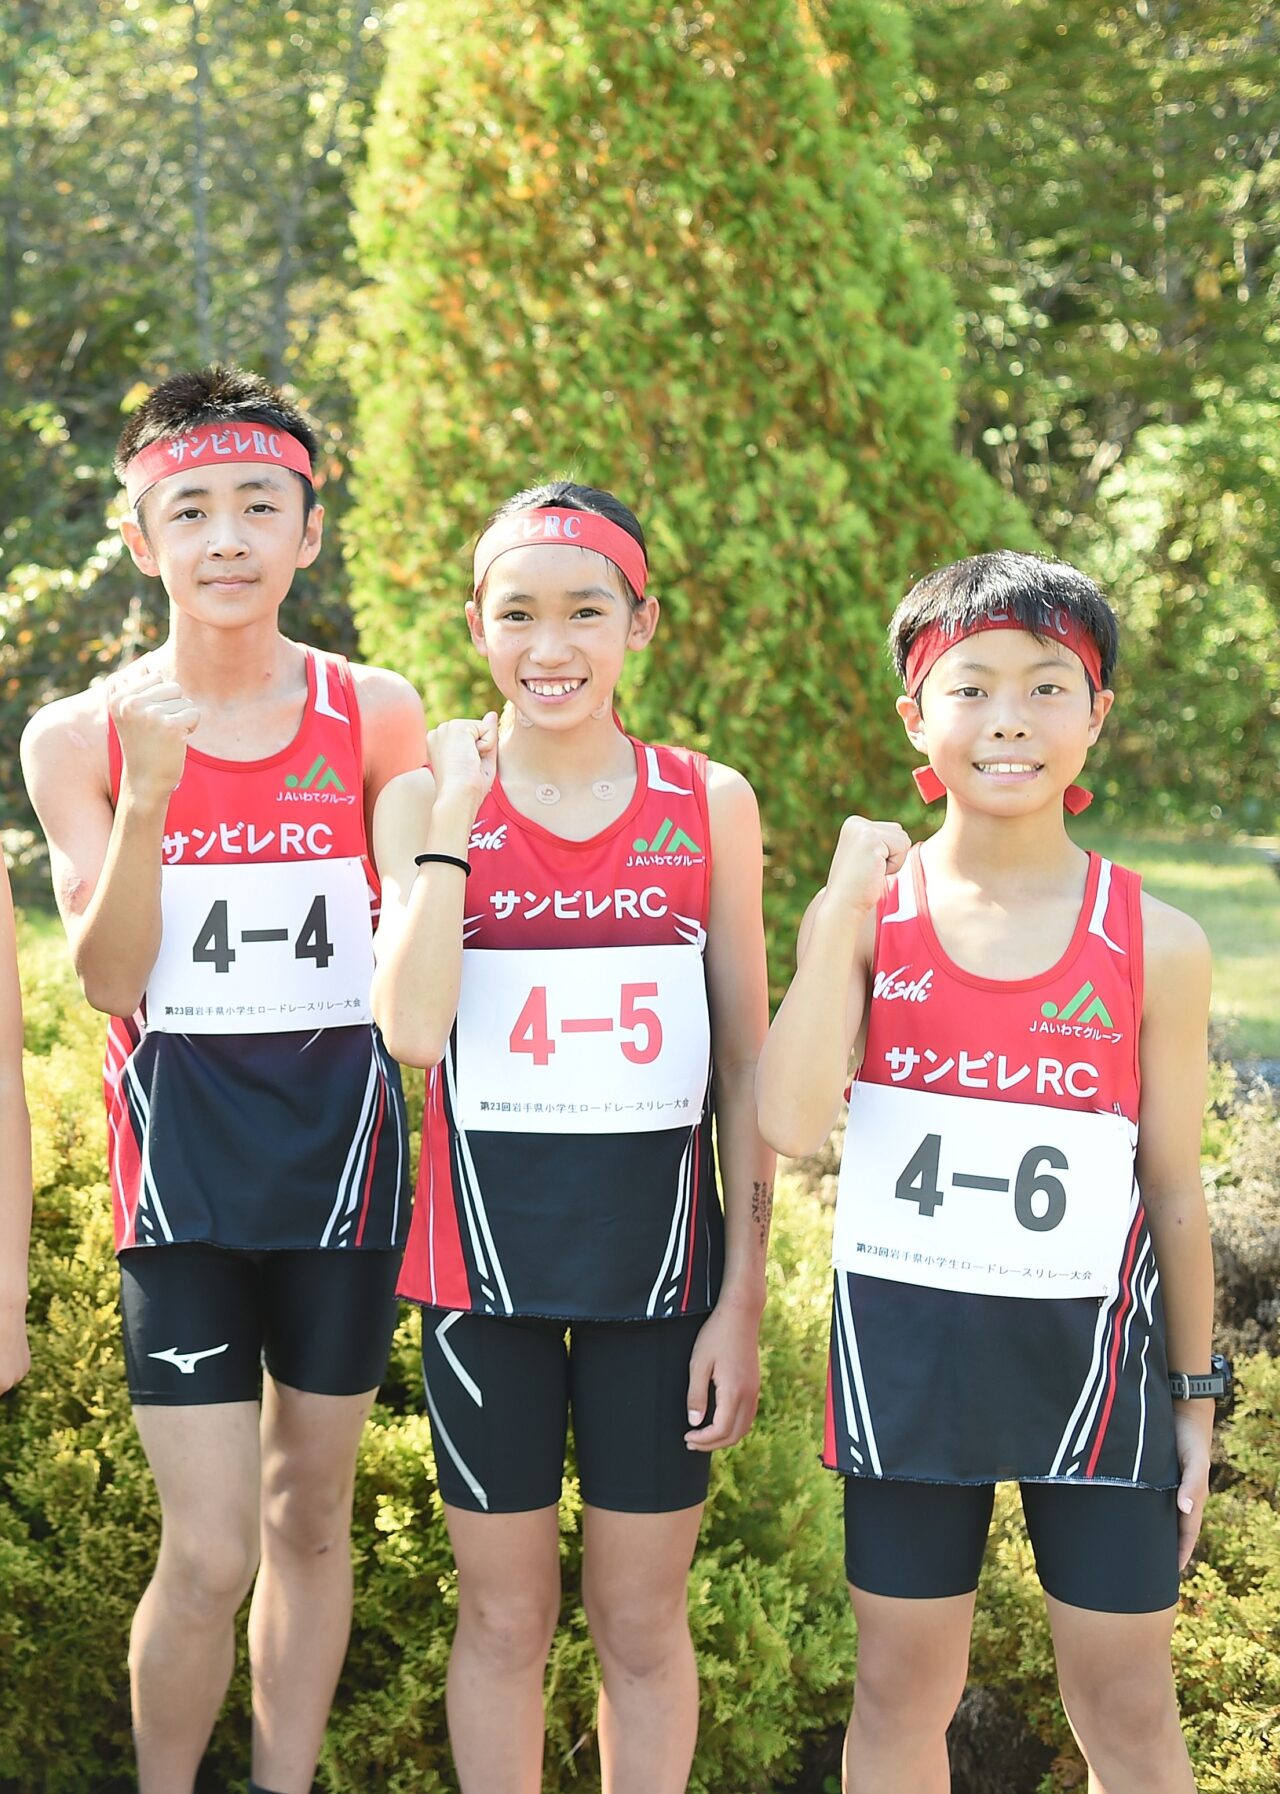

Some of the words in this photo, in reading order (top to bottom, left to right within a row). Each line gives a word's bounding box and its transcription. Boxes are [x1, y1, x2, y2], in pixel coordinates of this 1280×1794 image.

[167, 429, 283, 465] サンビレRC
[162, 821, 334, 865] サンビレRC
[626, 855, 705, 867] JAいわてグルー
[490, 886, 668, 920] サンビレRC
[193, 895, 334, 973] 4-4
[509, 981, 663, 1065] 4-5
[884, 1046, 1100, 1098] サンビレRC
[895, 1133, 1069, 1232] 4-6
